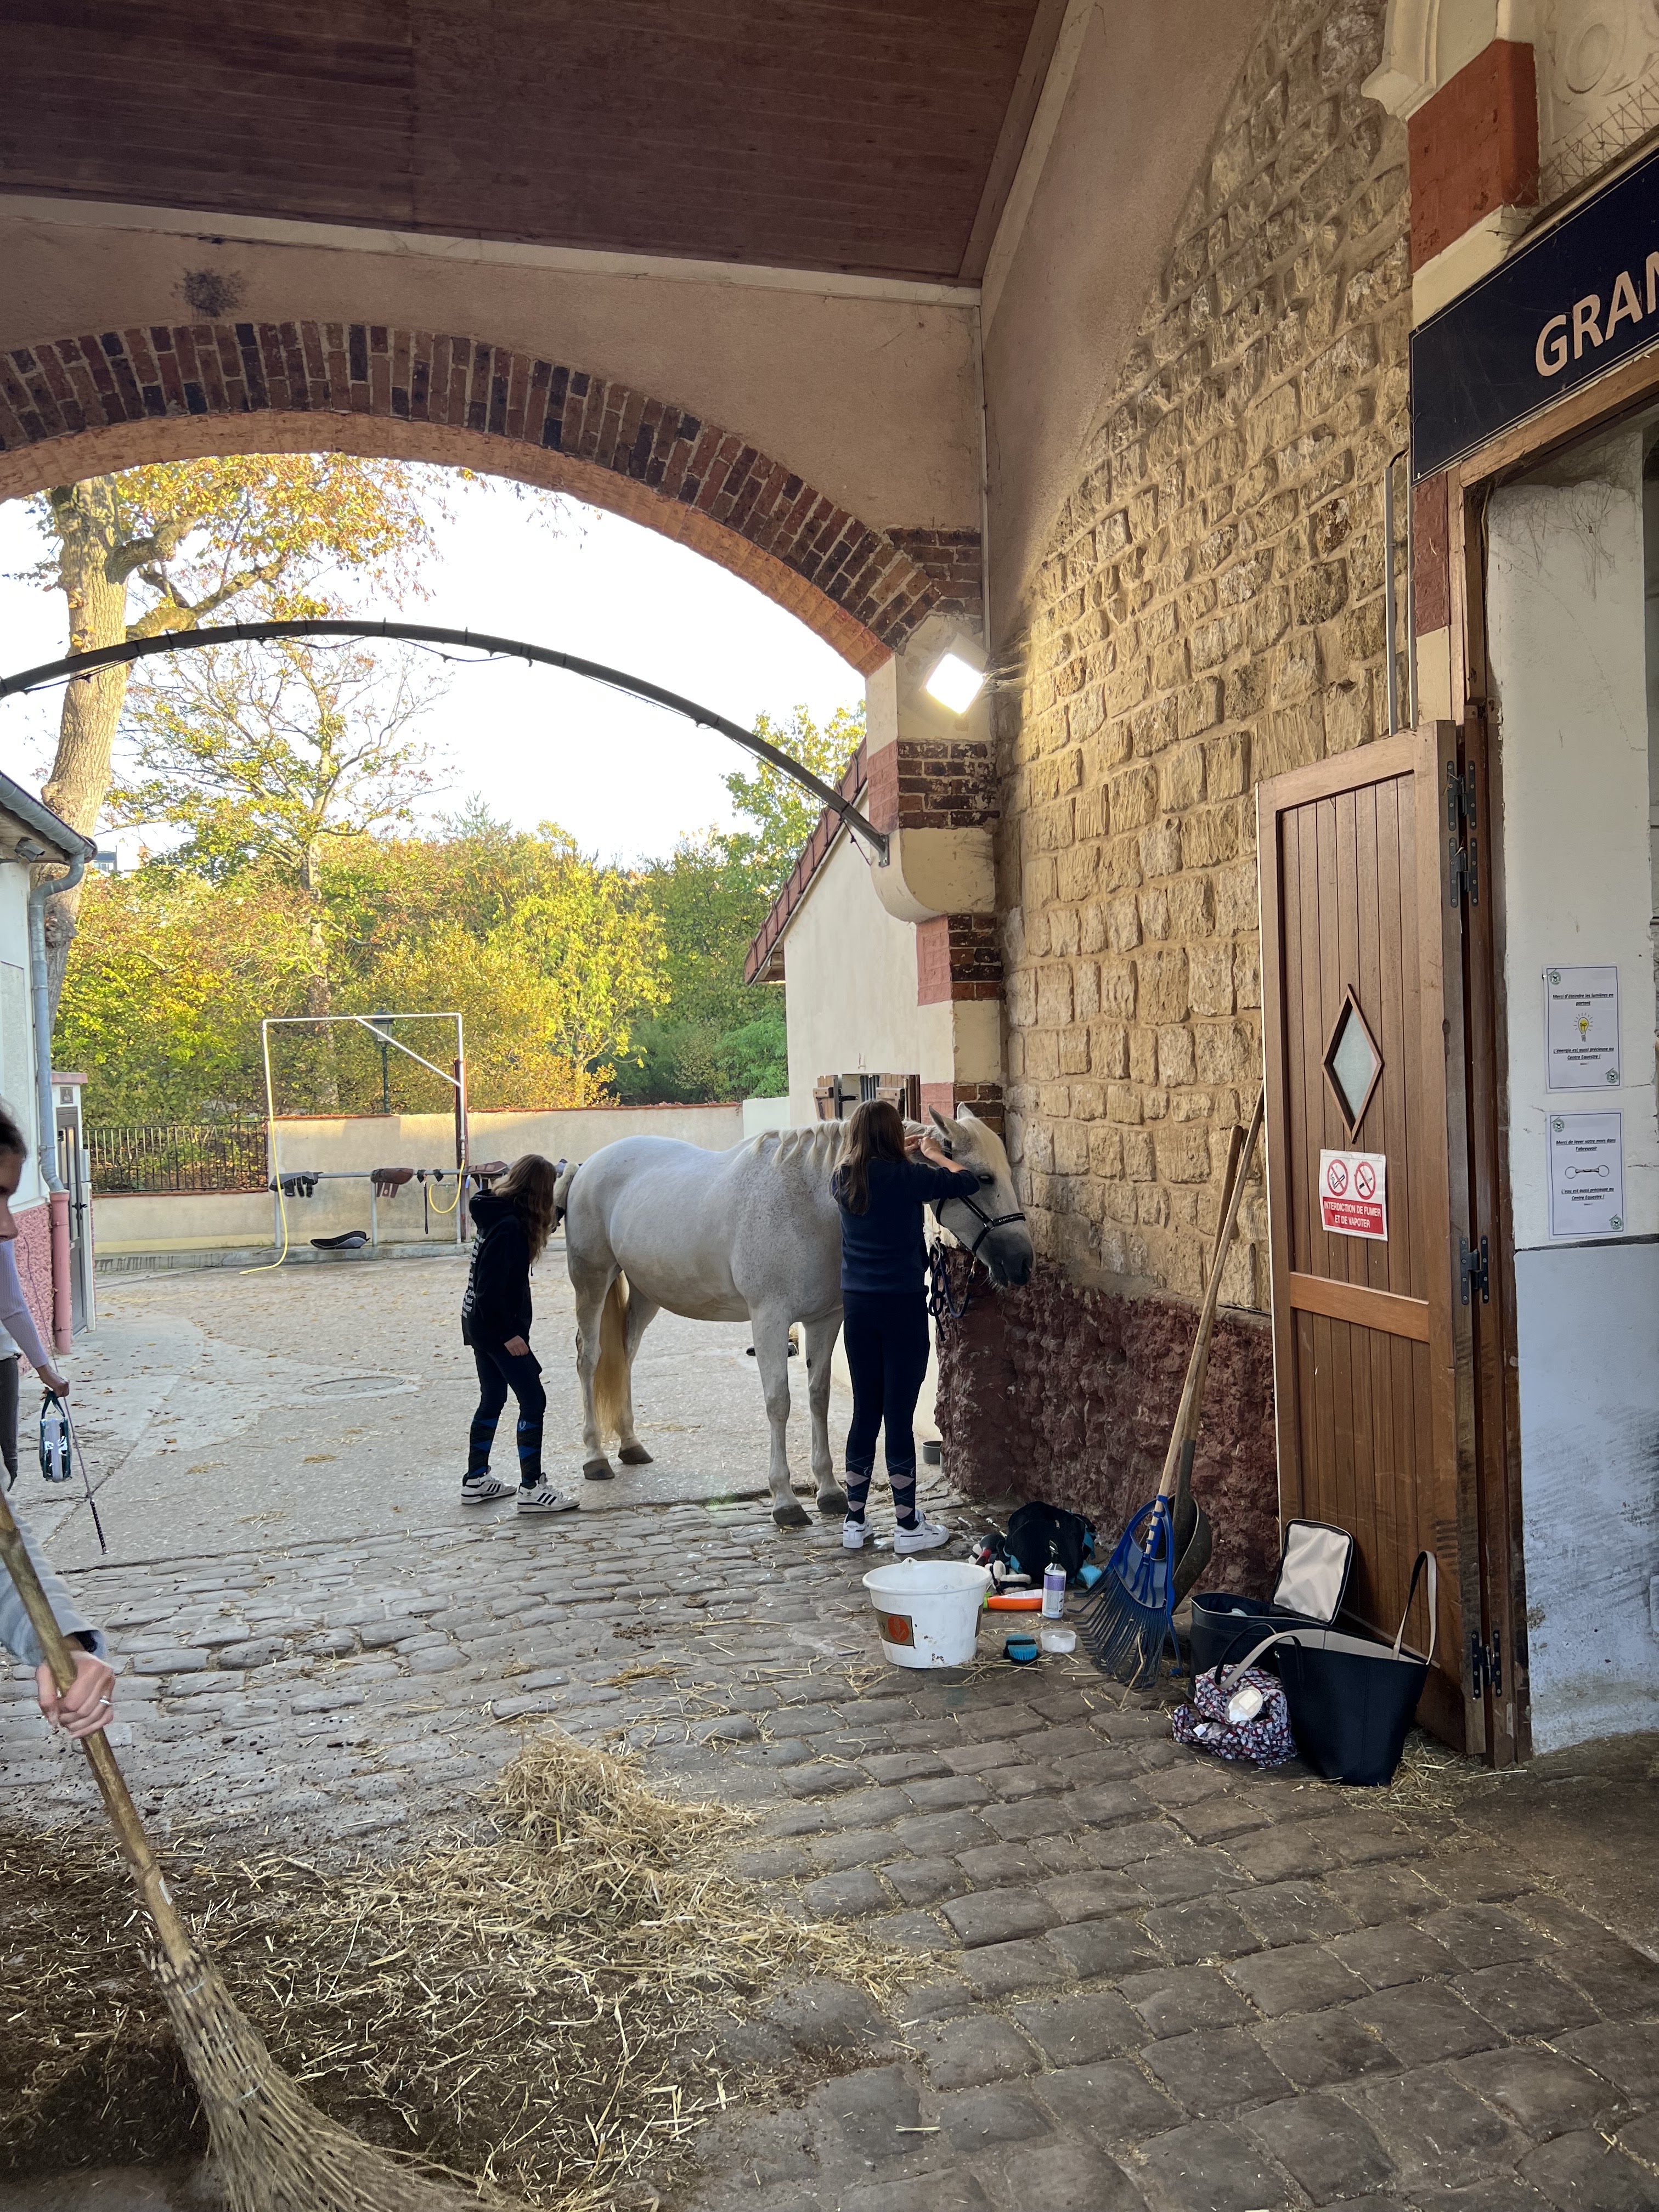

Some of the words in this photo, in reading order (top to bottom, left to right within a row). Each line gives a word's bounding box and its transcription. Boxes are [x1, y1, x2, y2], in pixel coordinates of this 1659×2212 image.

[1324, 1200, 1356, 1214] INTERDICTION
[1356, 1205, 1363, 1215] DE
[1364, 1206, 1381, 1217] FUMER
[1334, 1214, 1340, 1223] ET
[1341, 1215, 1348, 1224] DE
[1348, 1216, 1370, 1228] VAPOTER
